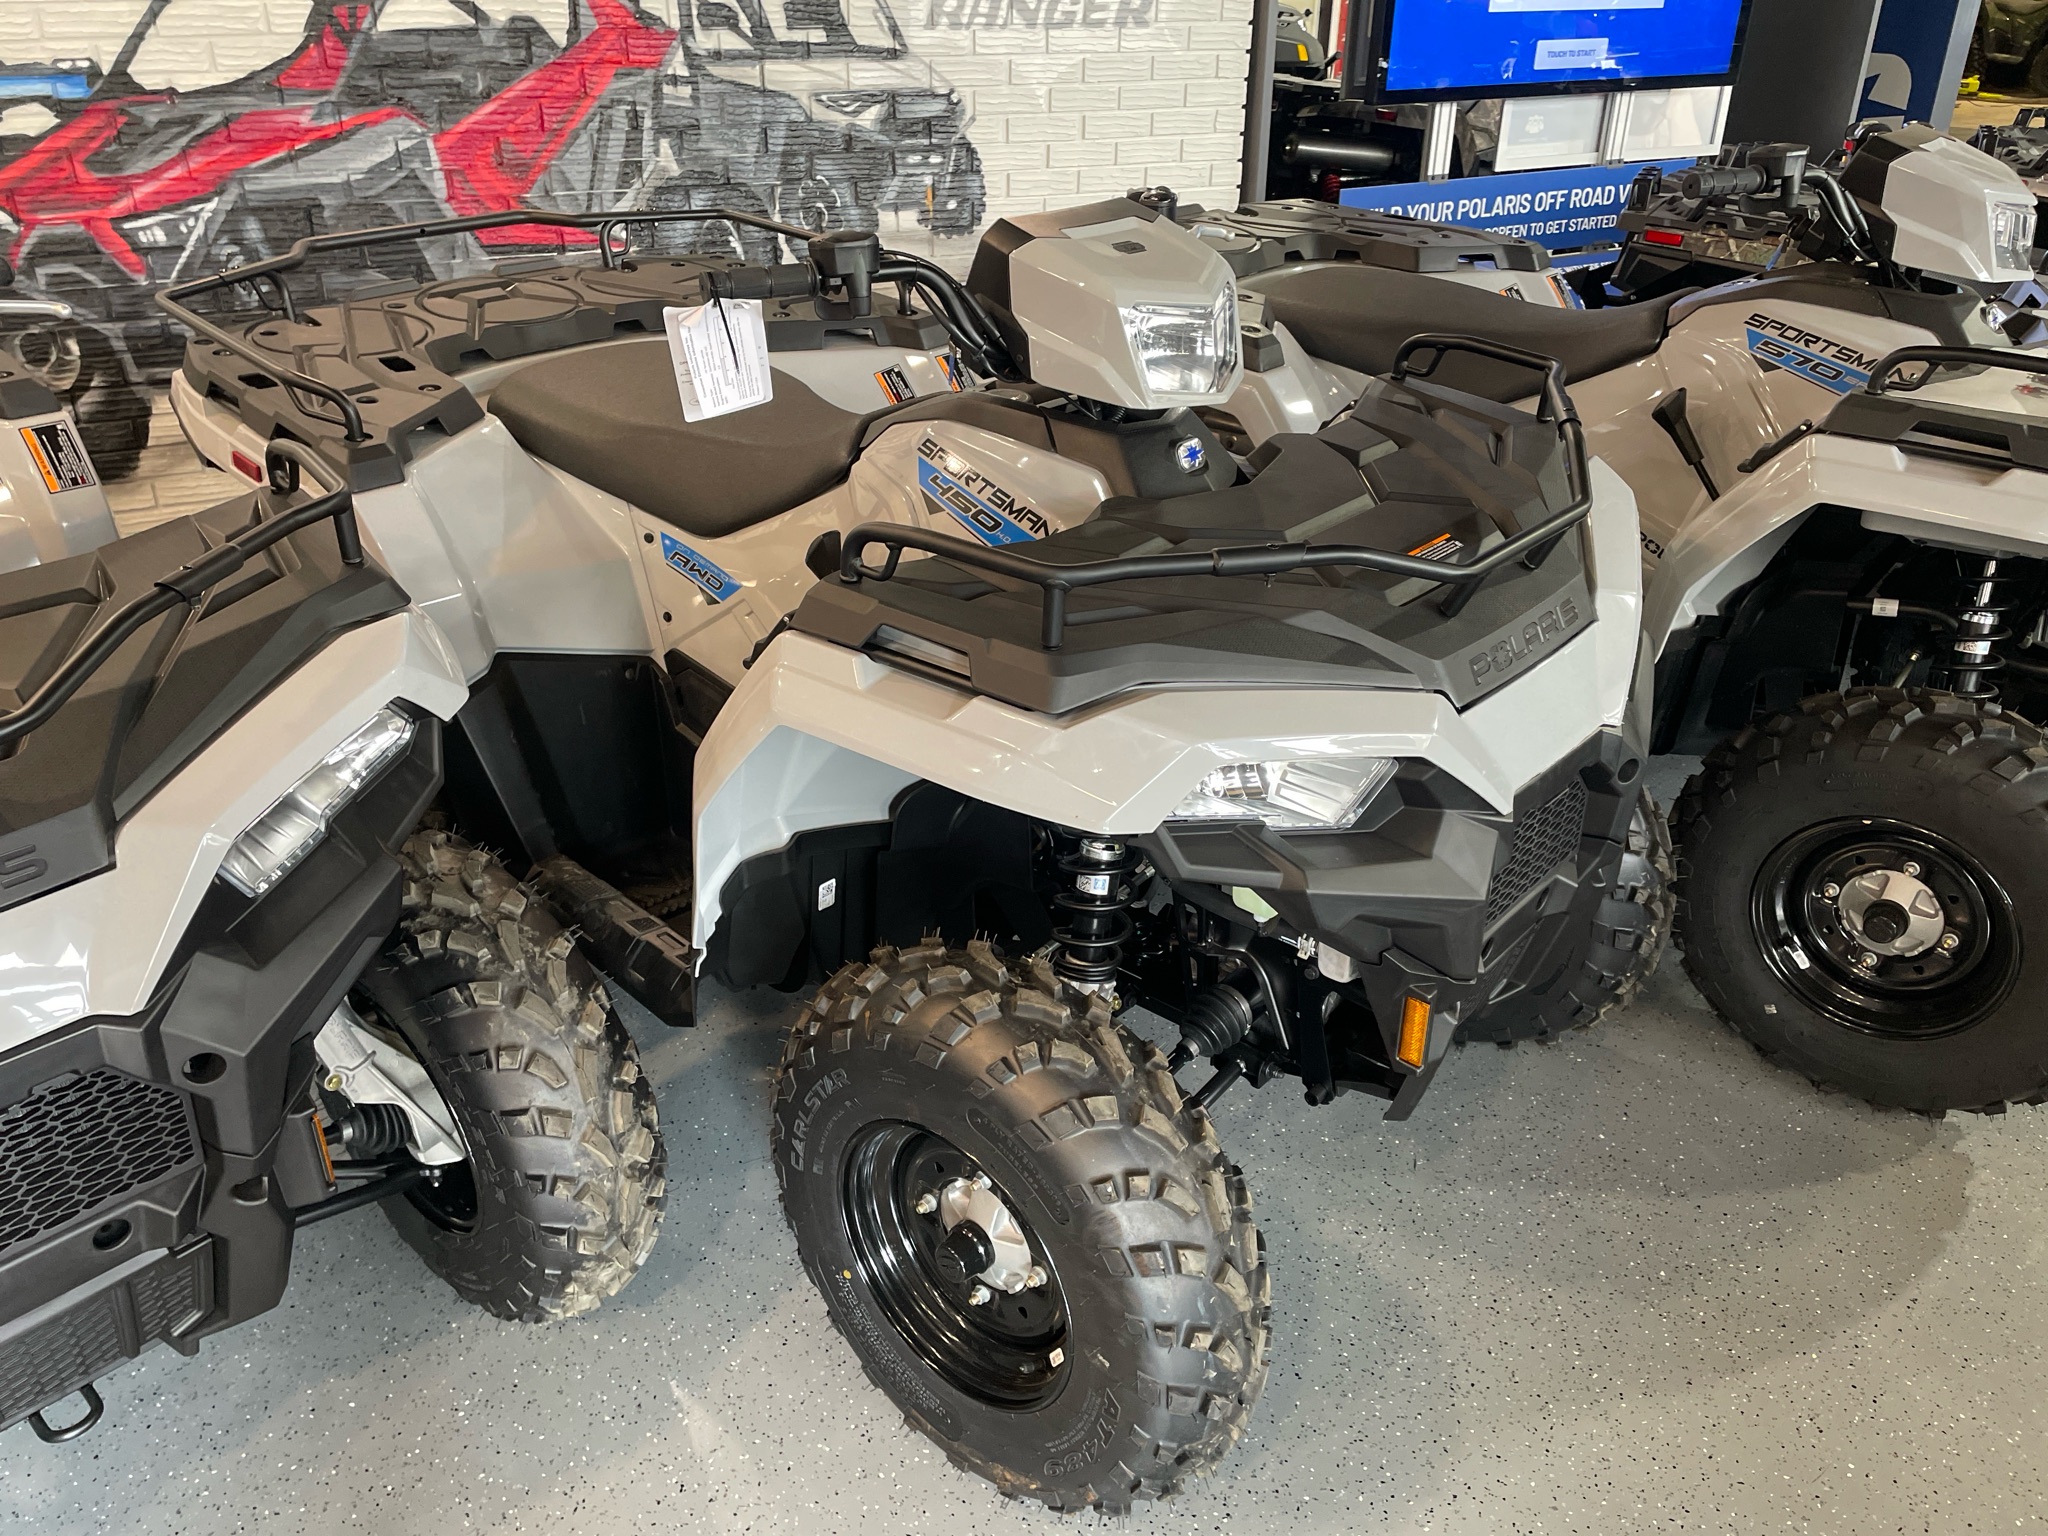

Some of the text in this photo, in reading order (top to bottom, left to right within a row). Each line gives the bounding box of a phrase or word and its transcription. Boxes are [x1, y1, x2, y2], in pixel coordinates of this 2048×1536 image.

[922, 0, 1151, 30] RANGER
[1547, 50, 1567, 59] TOUCH
[1577, 48, 1597, 57] START
[1407, 201, 1454, 223] YOUR
[1457, 192, 1532, 221] POLARIS
[1534, 189, 1568, 213] OFF
[1569, 184, 1616, 209] ROAD
[1531, 221, 1544, 237] TO
[1546, 219, 1569, 235] GET
[1569, 214, 1618, 232] STARTED
[1755, 339, 1844, 381] 570
[917, 438, 1059, 537] SPORTSMAN
[929, 474, 1003, 533] 450
[669, 551, 724, 591] AWD
[1469, 597, 1579, 687] POLARIS
[791, 1068, 851, 1172] CARLSTAR
[1043, 1387, 1121, 1477] AT489
